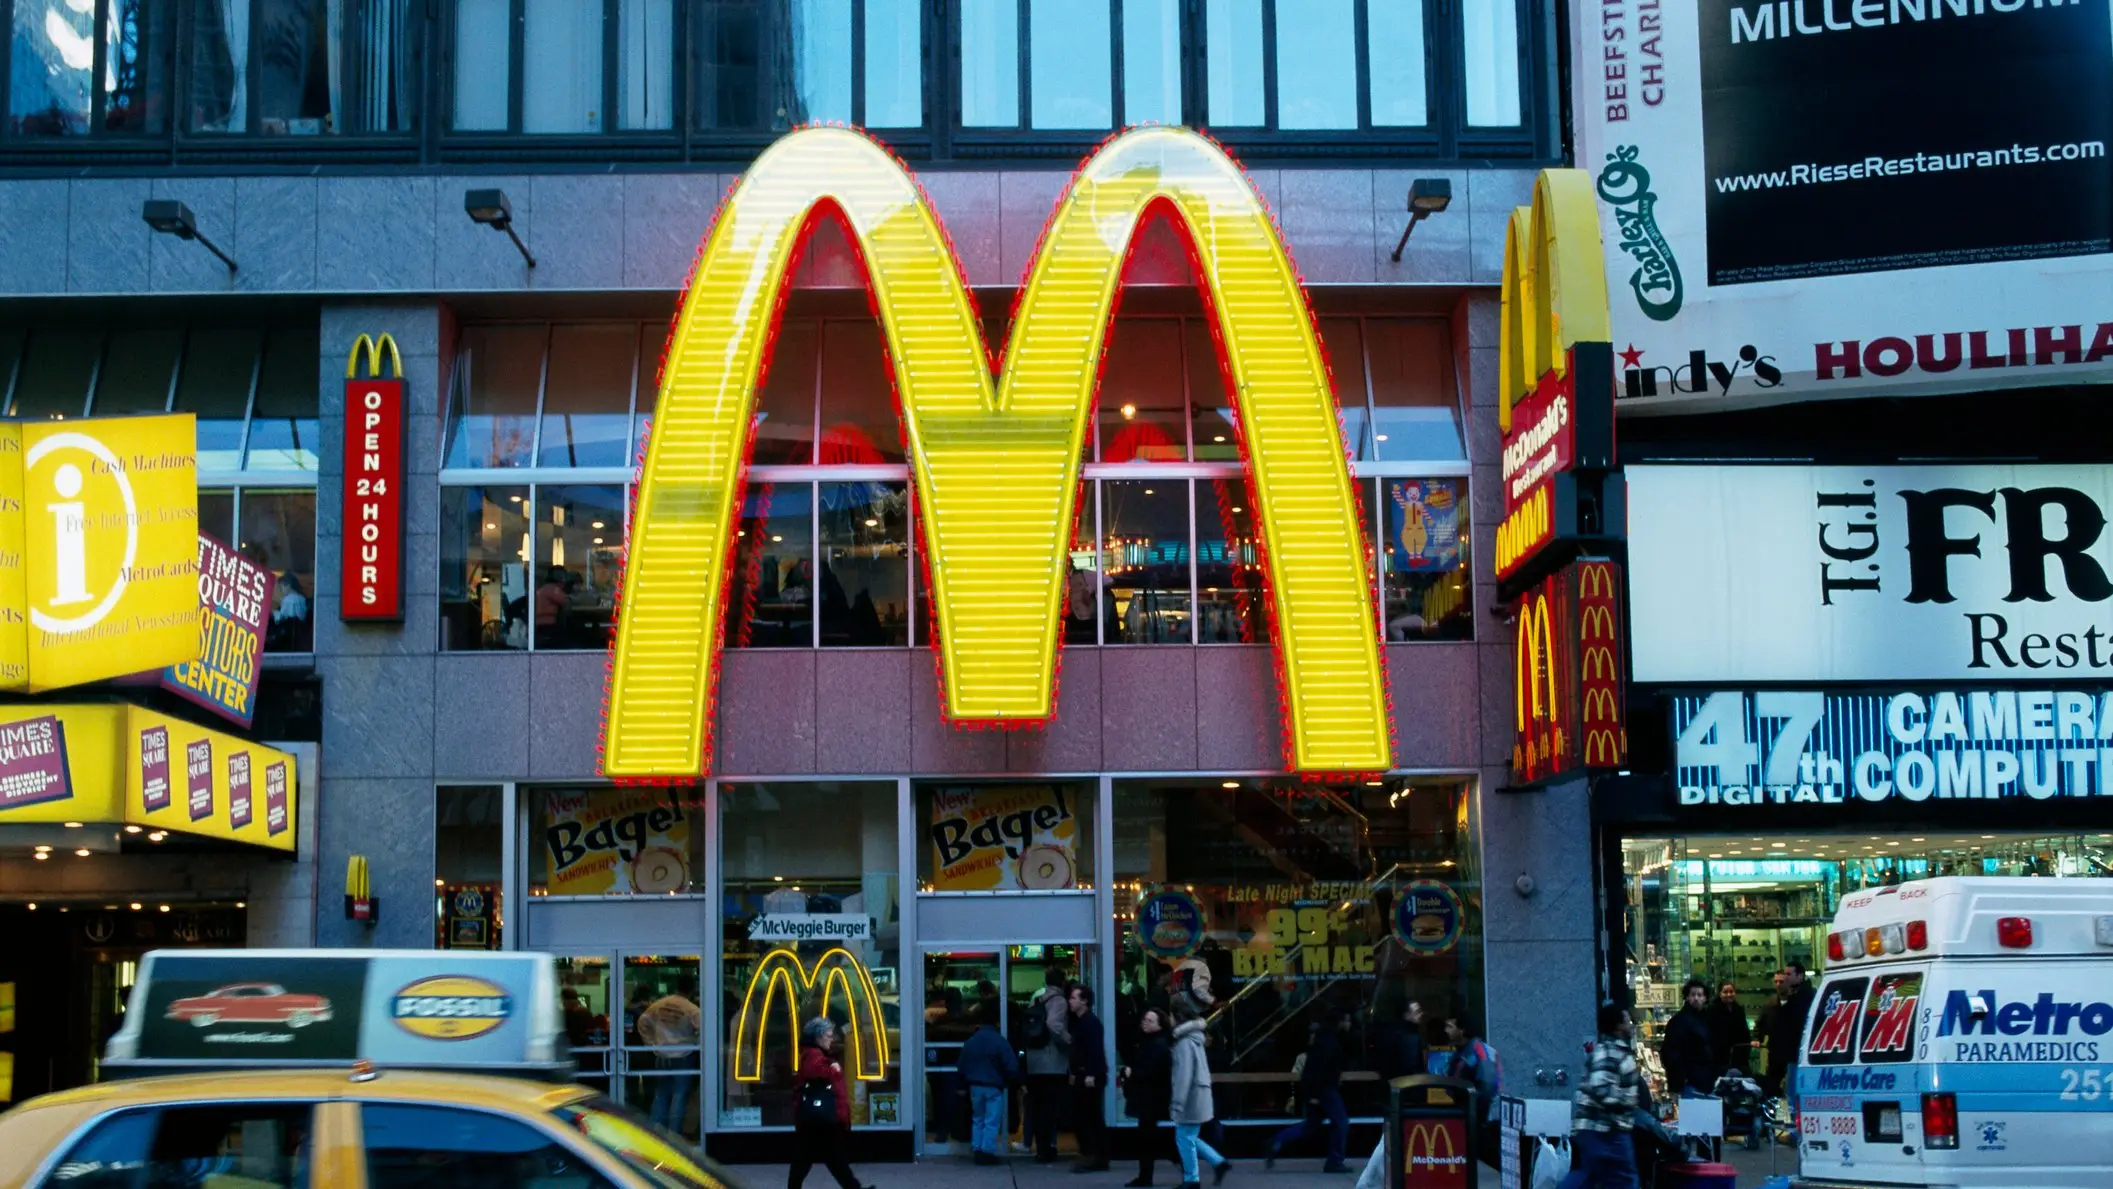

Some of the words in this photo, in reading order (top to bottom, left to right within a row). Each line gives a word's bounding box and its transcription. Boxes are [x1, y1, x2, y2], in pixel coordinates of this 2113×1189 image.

[1730, 0, 2081, 44] MILLENN
[1715, 140, 2105, 194] www.RieseRestaurants.com
[1615, 192, 1684, 322] Charley
[1615, 344, 1783, 399] indy's
[364, 391, 382, 471] OPEN
[1503, 394, 1568, 482] McDonald's
[91, 457, 126, 475] Cash
[133, 453, 196, 471] Machines
[356, 478, 387, 496] 24
[65, 514, 93, 533] Free
[120, 558, 199, 583] MetroCards
[198, 534, 266, 602] TIMES
[362, 503, 380, 605] HOURS
[198, 573, 262, 628] QUARE
[41, 617, 130, 648] International
[135, 605, 200, 628] Newsstand
[198, 605, 258, 685] SITORS
[173, 660, 249, 714] CENTER
[1680, 785, 1844, 805] DIGITAL
[547, 787, 686, 870] Bagel
[932, 784, 1072, 867] Bagel
[1227, 884, 1261, 902] Late
[1265, 883, 1304, 904] Night
[1311, 880, 1375, 900] SPECIAL
[1847, 897, 1872, 909] KEEP
[1900, 888, 1928, 901] BACK
[824, 919, 866, 938] Burger
[1232, 947, 1286, 977] BIG
[1302, 945, 1376, 975] MAC
[1936, 989, 2113, 1037] Metro
[1956, 1042, 2099, 1062] PARAMEDICS
[1413, 1156, 1467, 1165] McDonald's
